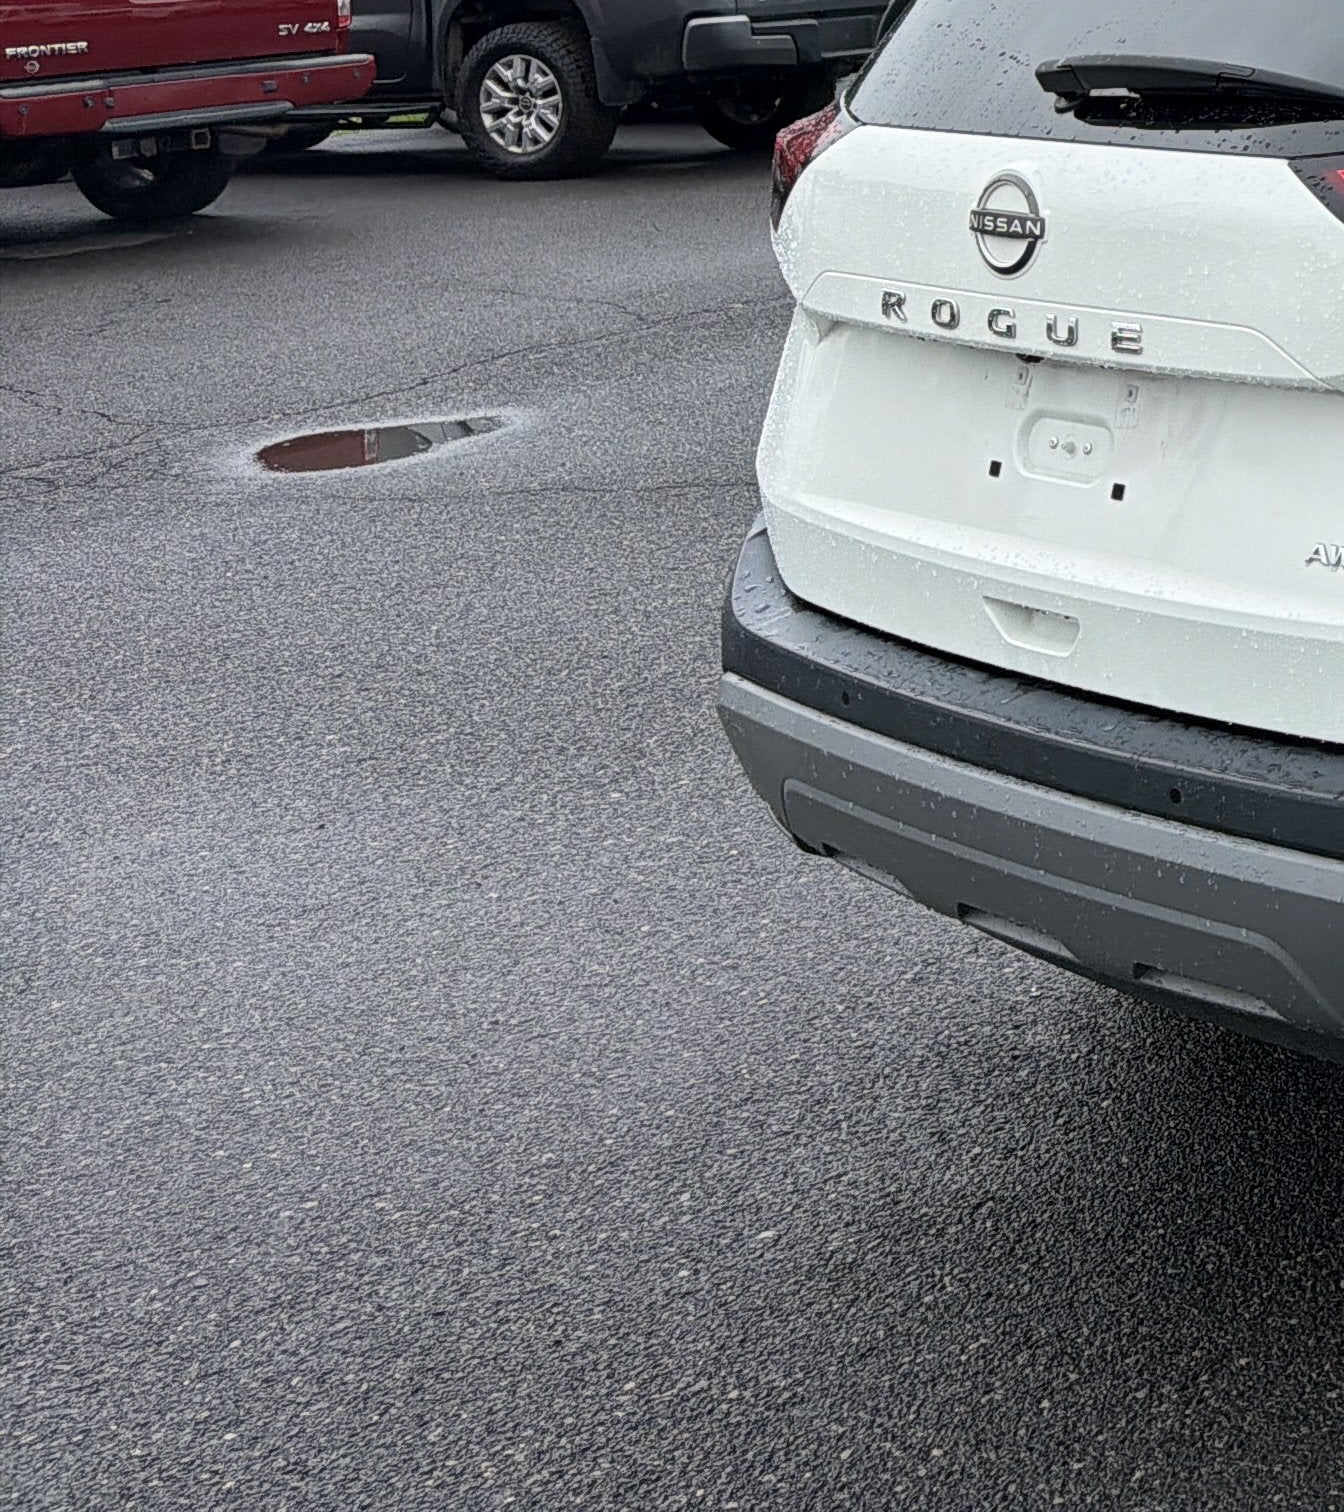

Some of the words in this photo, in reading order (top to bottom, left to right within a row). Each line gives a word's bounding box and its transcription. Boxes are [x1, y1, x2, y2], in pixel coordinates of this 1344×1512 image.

[278, 23, 299, 36] SV
[5, 41, 89, 59] FRONTIER
[969, 212, 1042, 236] NISSAN
[881, 288, 1144, 354] ROGUE
